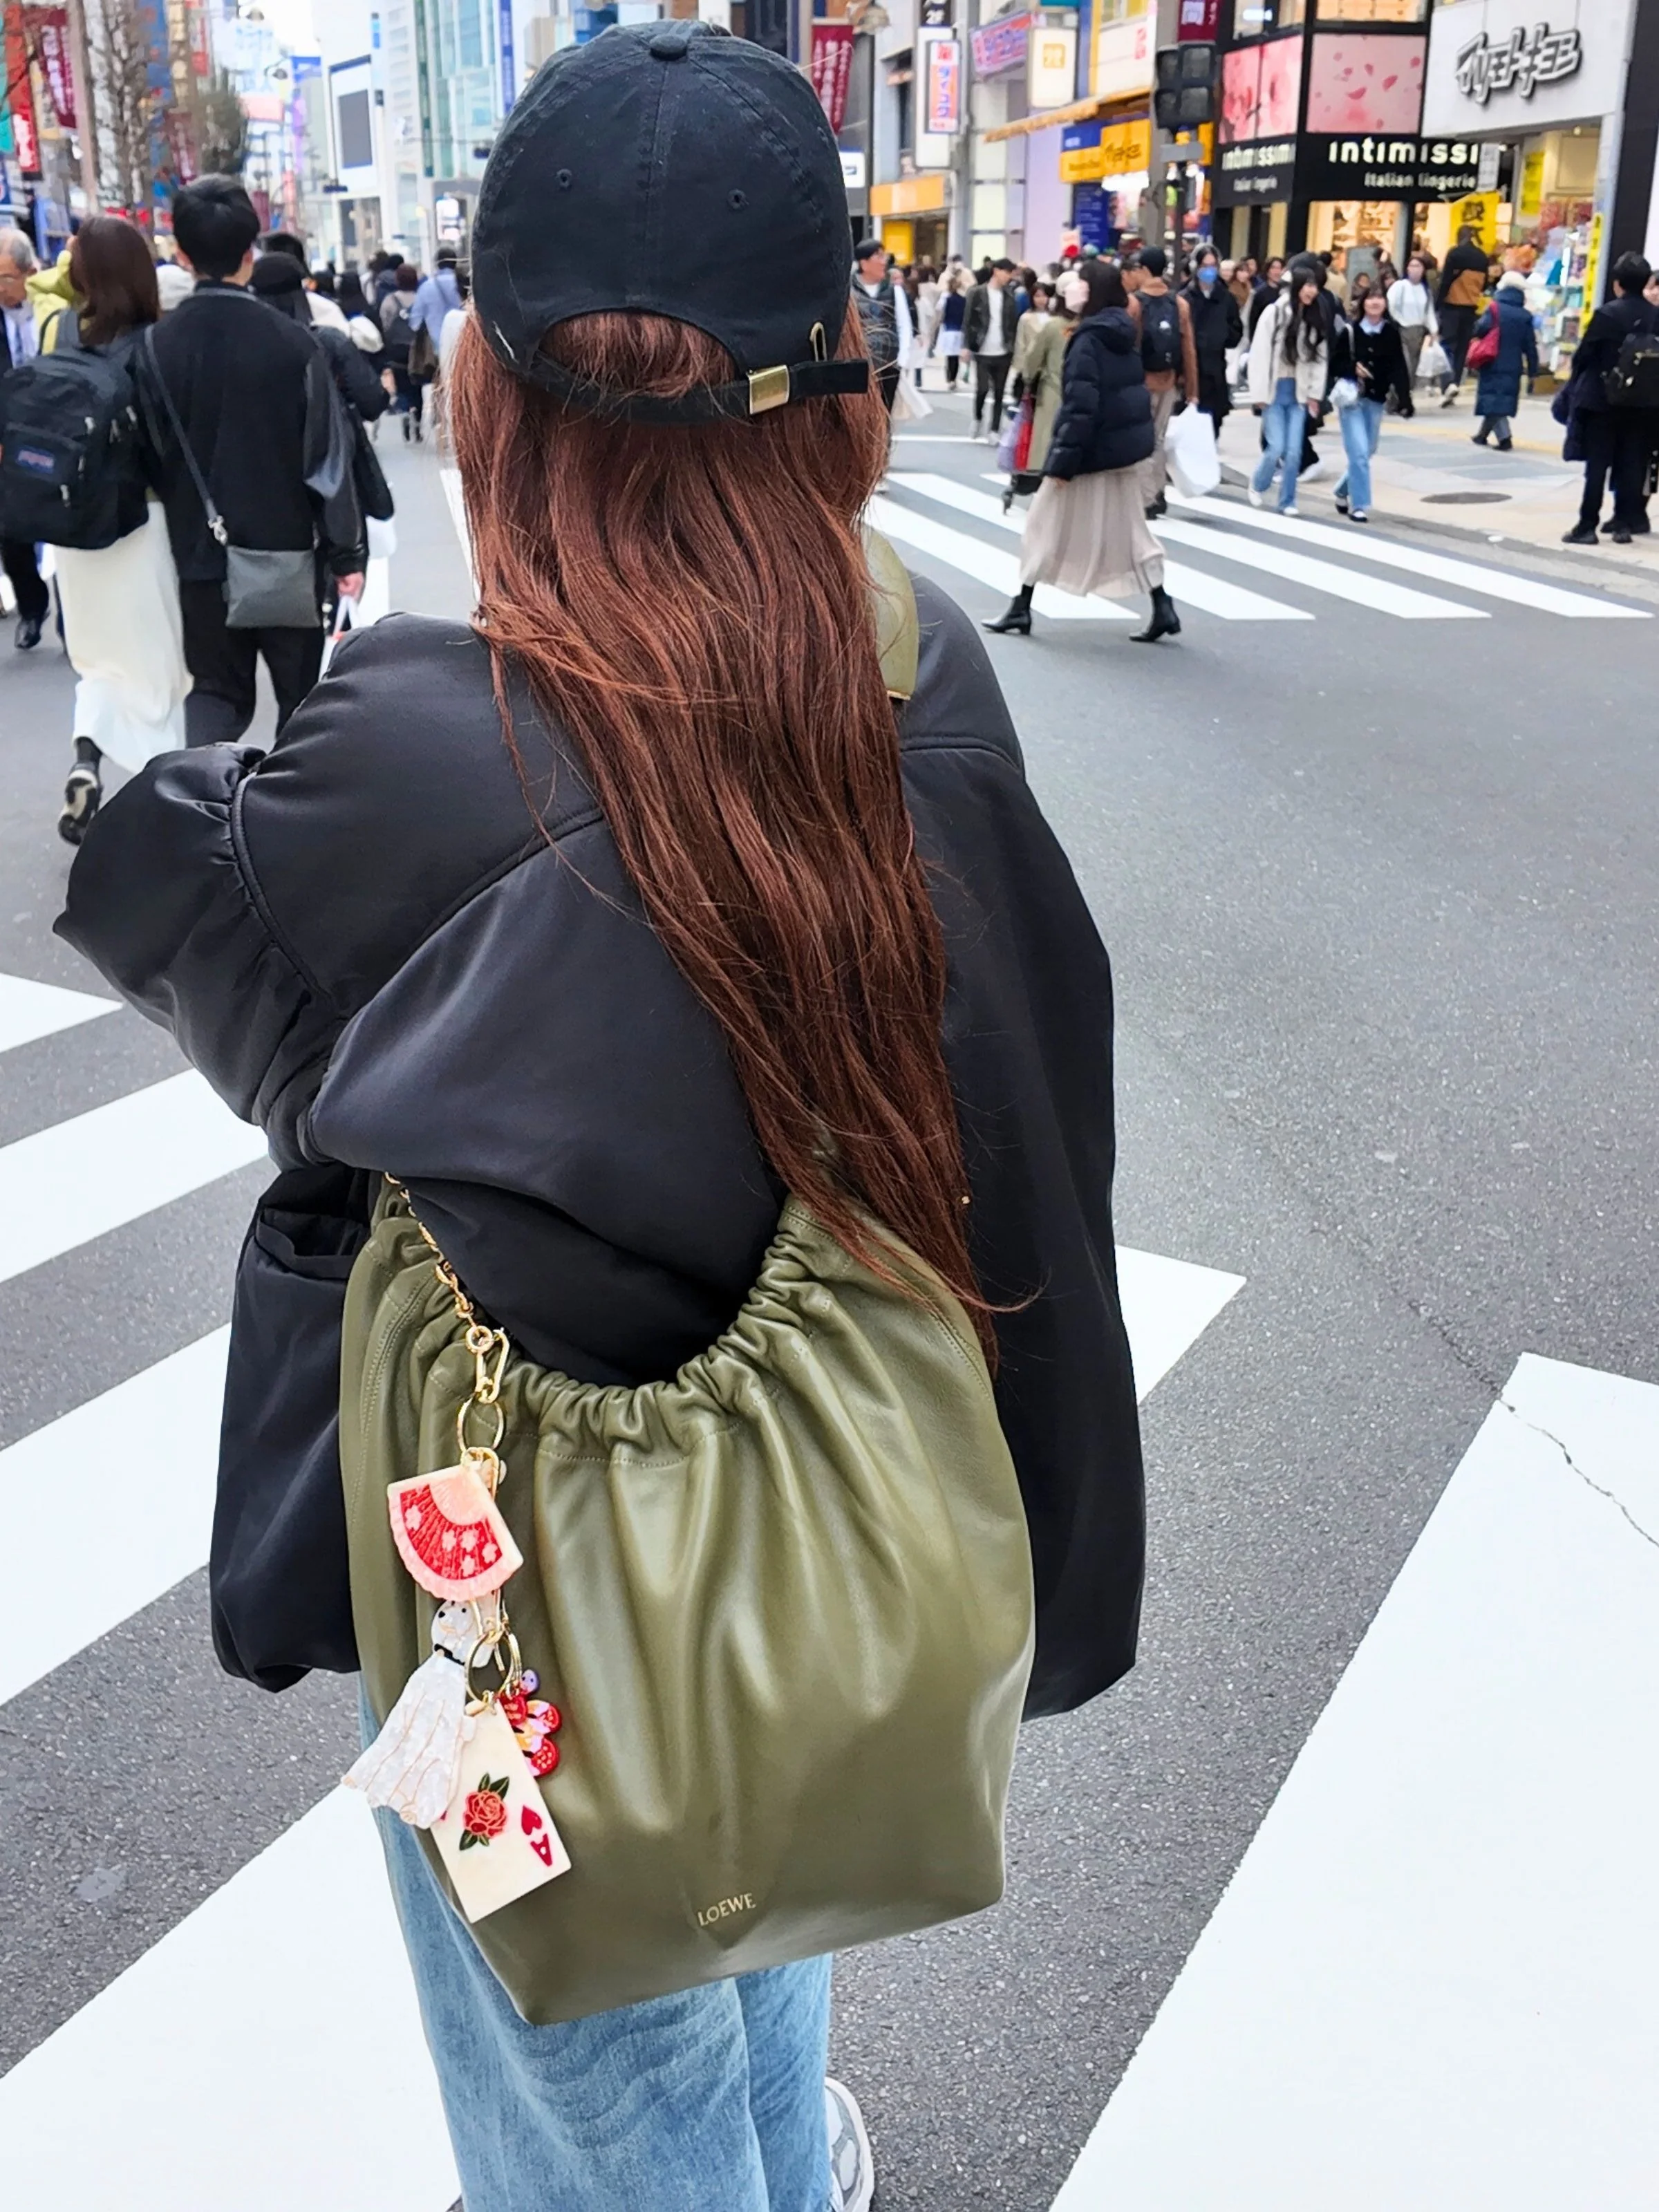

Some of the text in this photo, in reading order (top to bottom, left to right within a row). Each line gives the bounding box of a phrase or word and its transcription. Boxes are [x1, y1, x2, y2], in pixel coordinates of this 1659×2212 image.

[1364, 172, 1477, 191] Italian lingerie
[529, 1833, 553, 1867] A
[697, 1892, 757, 1927] LOEWE
